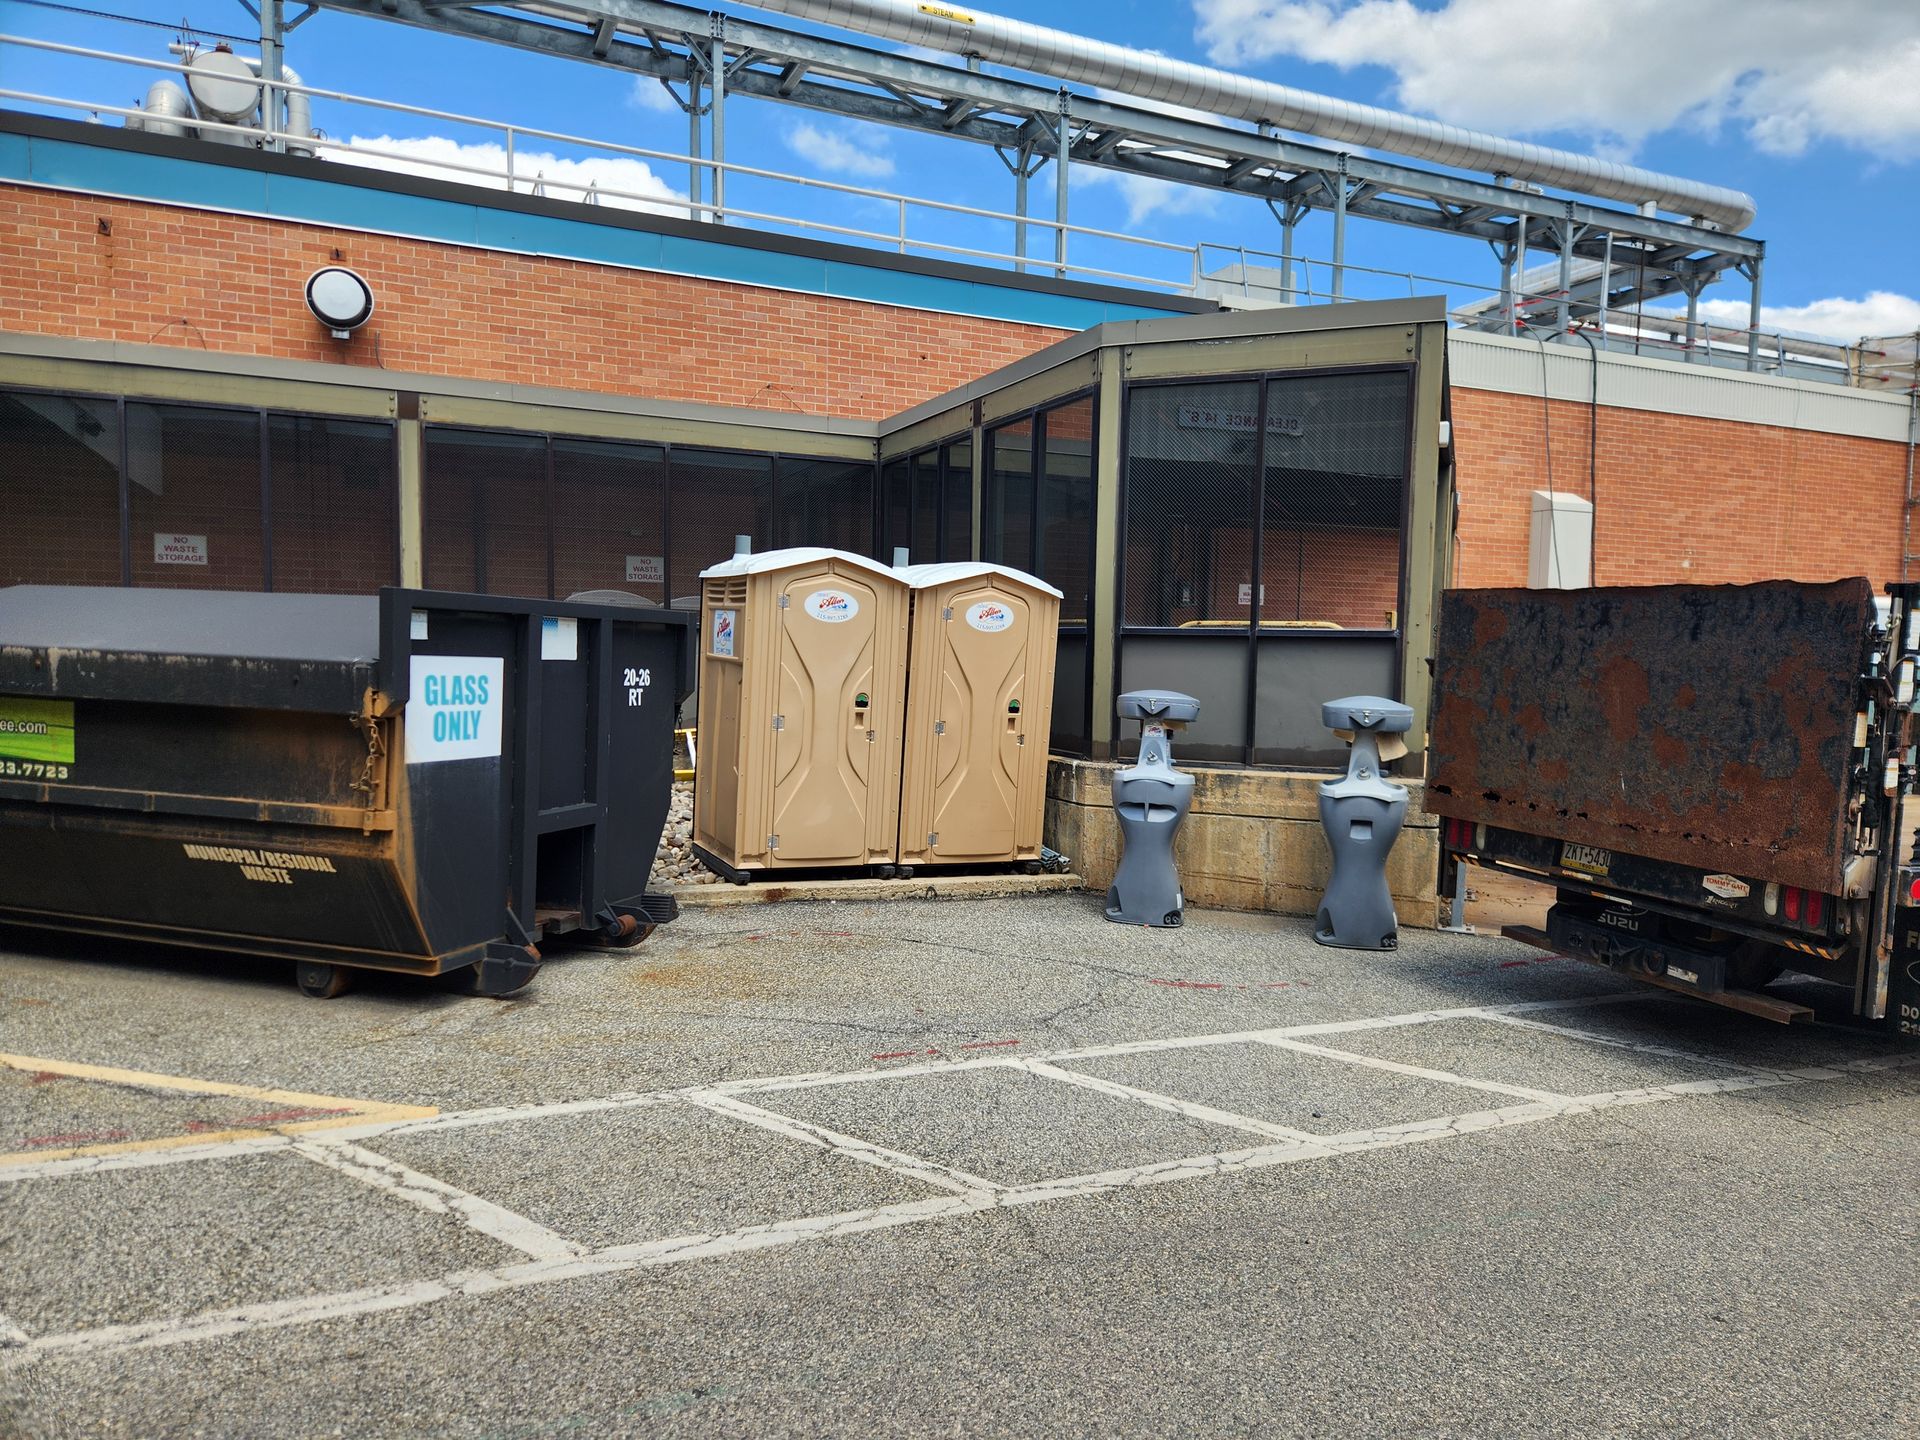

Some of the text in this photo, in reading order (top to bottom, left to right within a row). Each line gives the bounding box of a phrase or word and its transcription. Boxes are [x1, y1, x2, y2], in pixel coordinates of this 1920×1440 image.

[933, 7, 954, 18] STEAM
[174, 536, 188, 544] NO
[164, 544, 198, 553] WASTE
[158, 553, 205, 563] STORAGE
[640, 558, 652, 566] NO
[633, 565, 659, 573] WASTE
[628, 573, 664, 581] STORAGE
[624, 668, 650, 686] 20-26
[424, 675, 489, 706] GLASS
[629, 688, 643, 706] RT
[433, 710, 482, 743] ONLY
[182, 843, 337, 873] MUNICIPAL/RESIDUAL
[239, 865, 294, 884] WASTE
[1705, 876, 1731, 888] TOMMY
